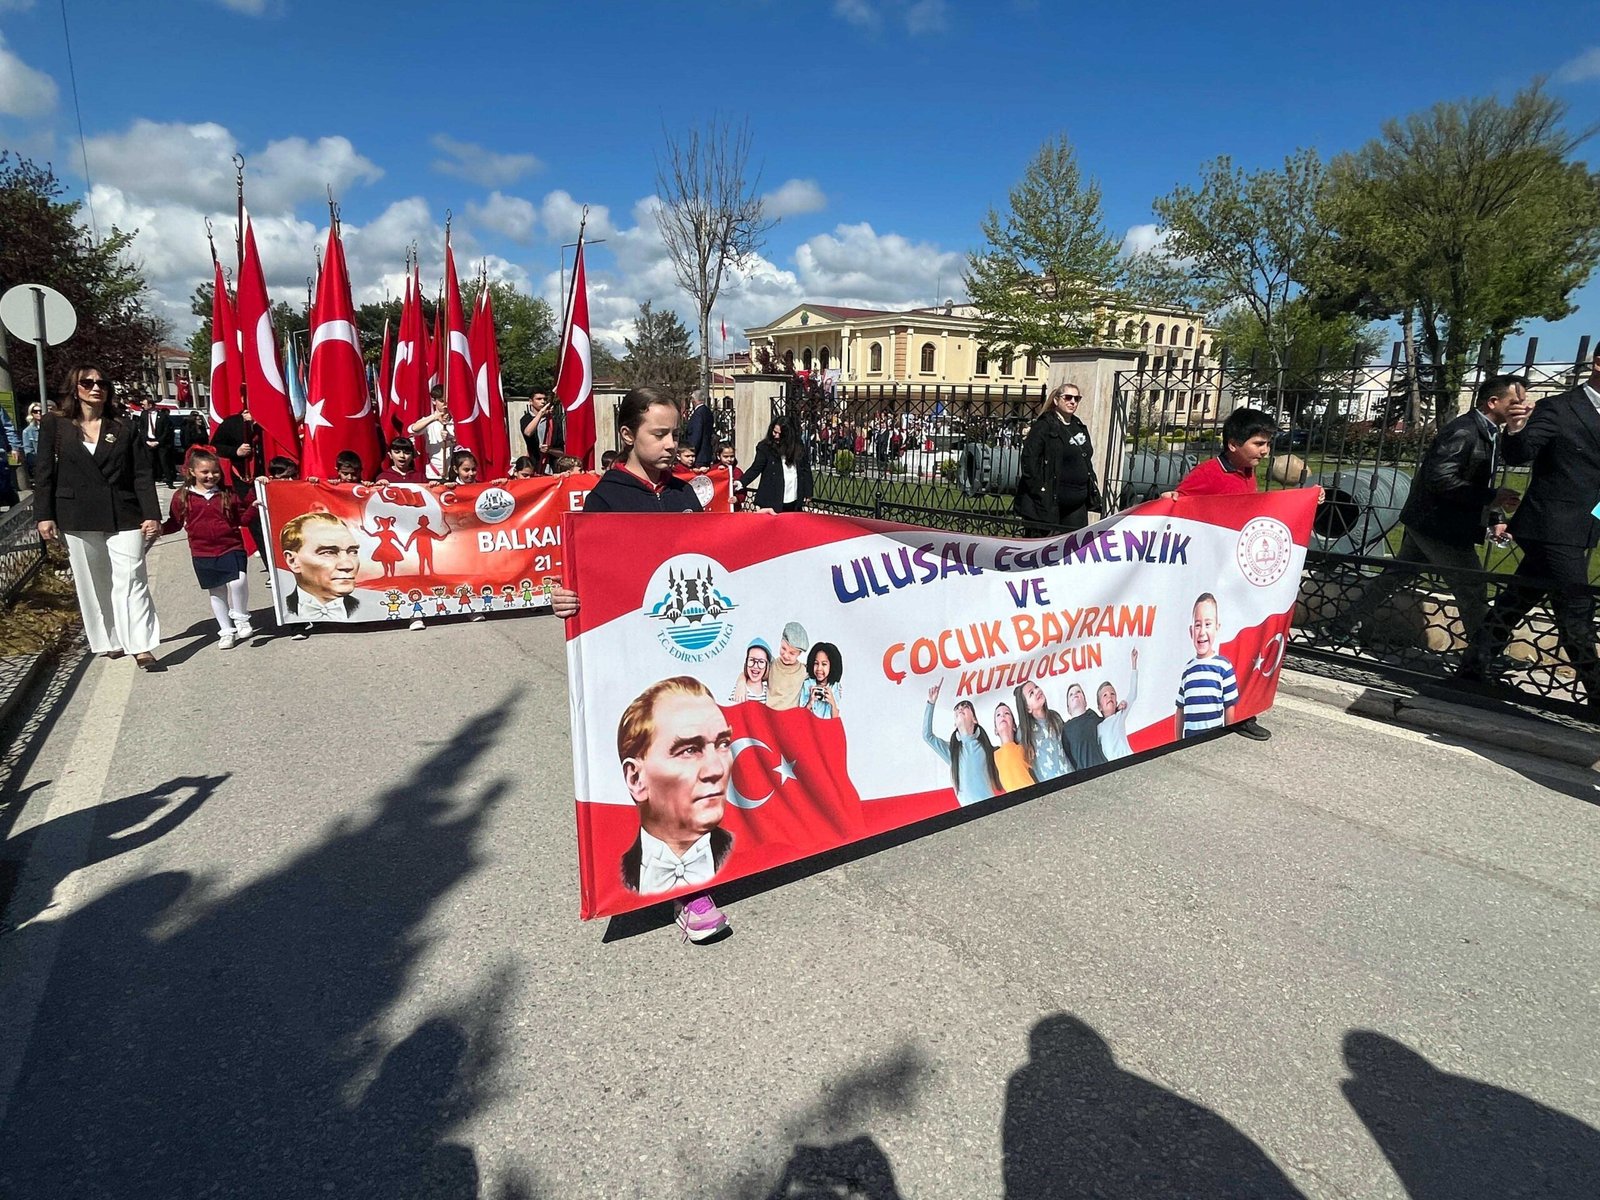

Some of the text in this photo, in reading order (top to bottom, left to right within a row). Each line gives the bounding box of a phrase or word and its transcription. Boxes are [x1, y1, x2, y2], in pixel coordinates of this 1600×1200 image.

[534, 554, 551, 572] 21
[831, 541, 984, 604] ULUSAL
[994, 523, 1192, 572] EGEMENLİK
[1005, 577, 1051, 609] VE
[668, 646, 705, 663] EDİRNE
[882, 604, 1158, 685] ÇOCUK BAYRAMI
[955, 643, 1103, 697] KUTLU OLSUN
